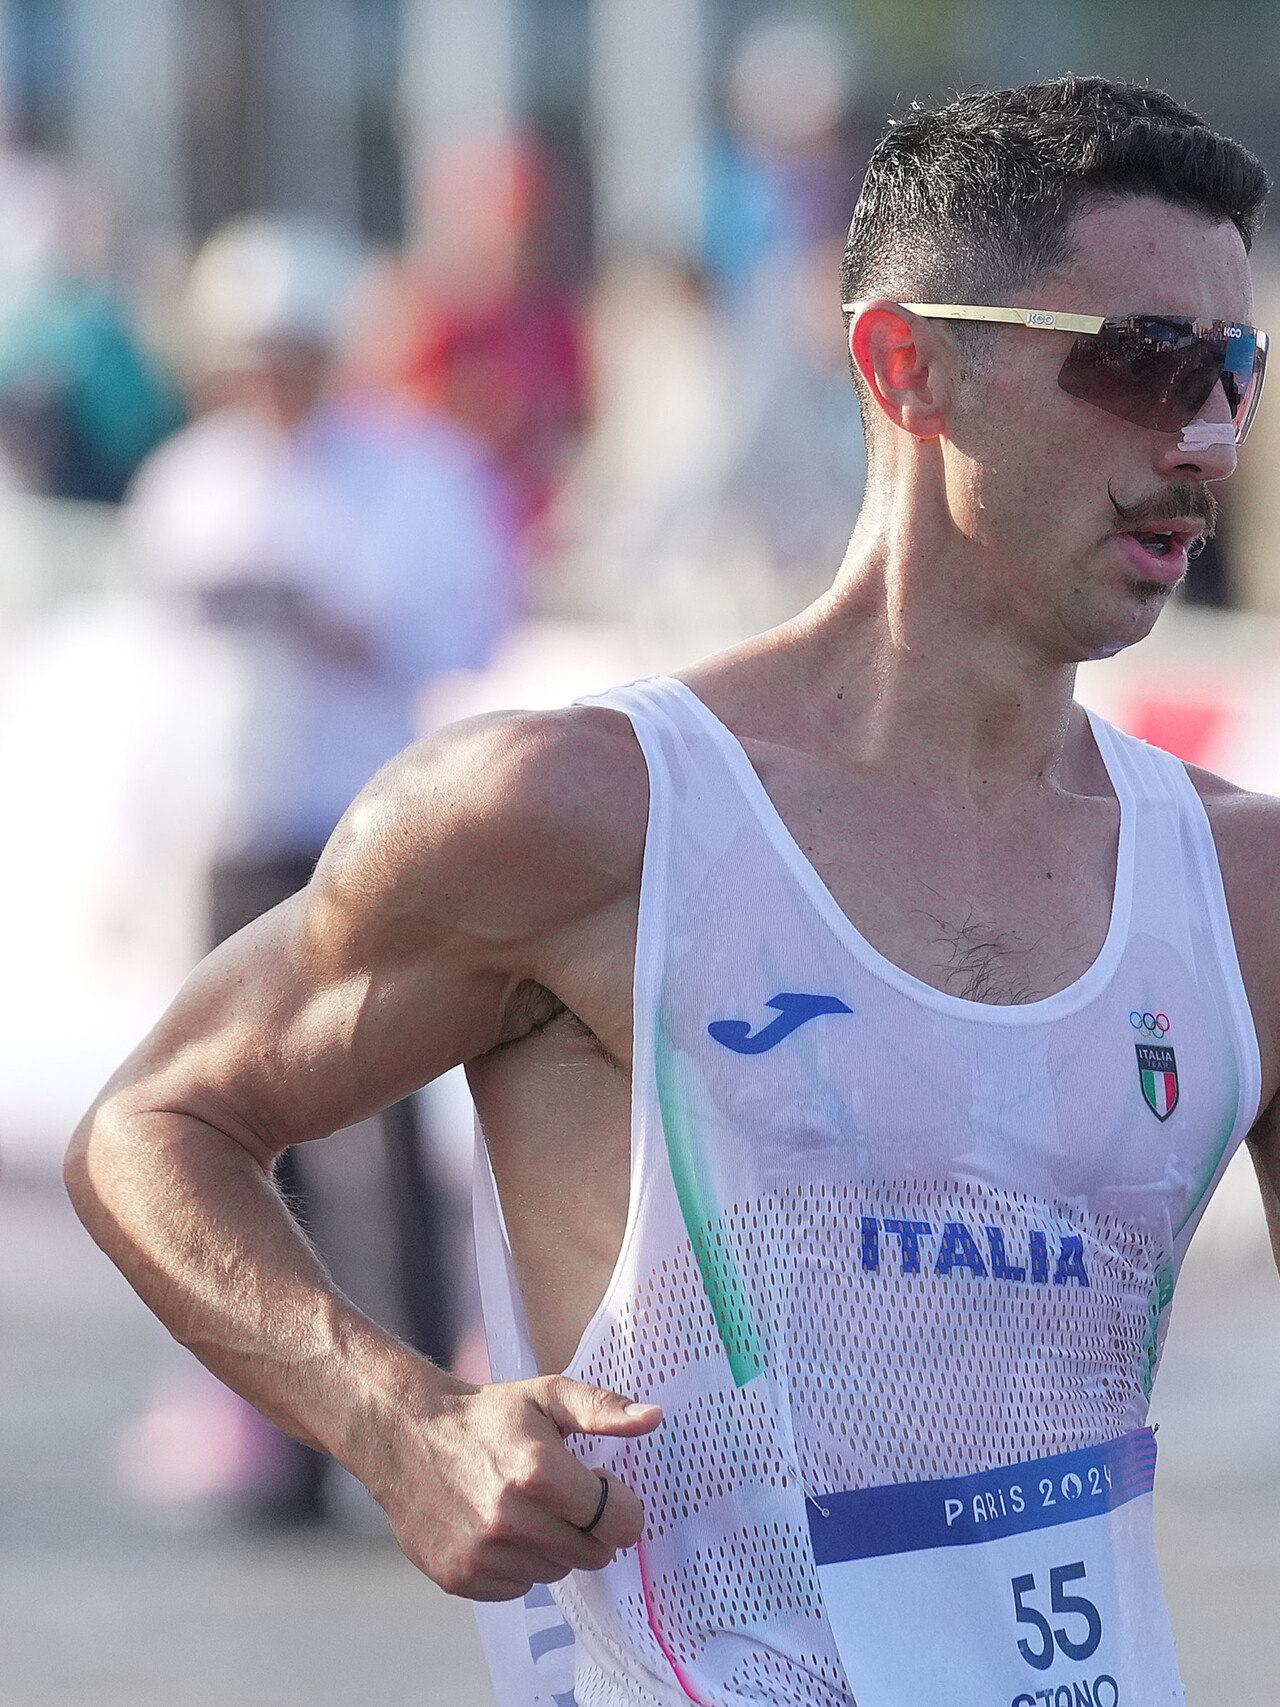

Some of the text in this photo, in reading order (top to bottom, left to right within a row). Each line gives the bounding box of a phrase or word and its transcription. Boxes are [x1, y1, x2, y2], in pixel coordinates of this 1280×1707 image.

[1138, 1048, 1173, 1062] ITALIA
[861, 1216, 1090, 1288] ITALIA
[1038, 1464, 1113, 1508] 2024
[1011, 1560, 1102, 1671] 55
